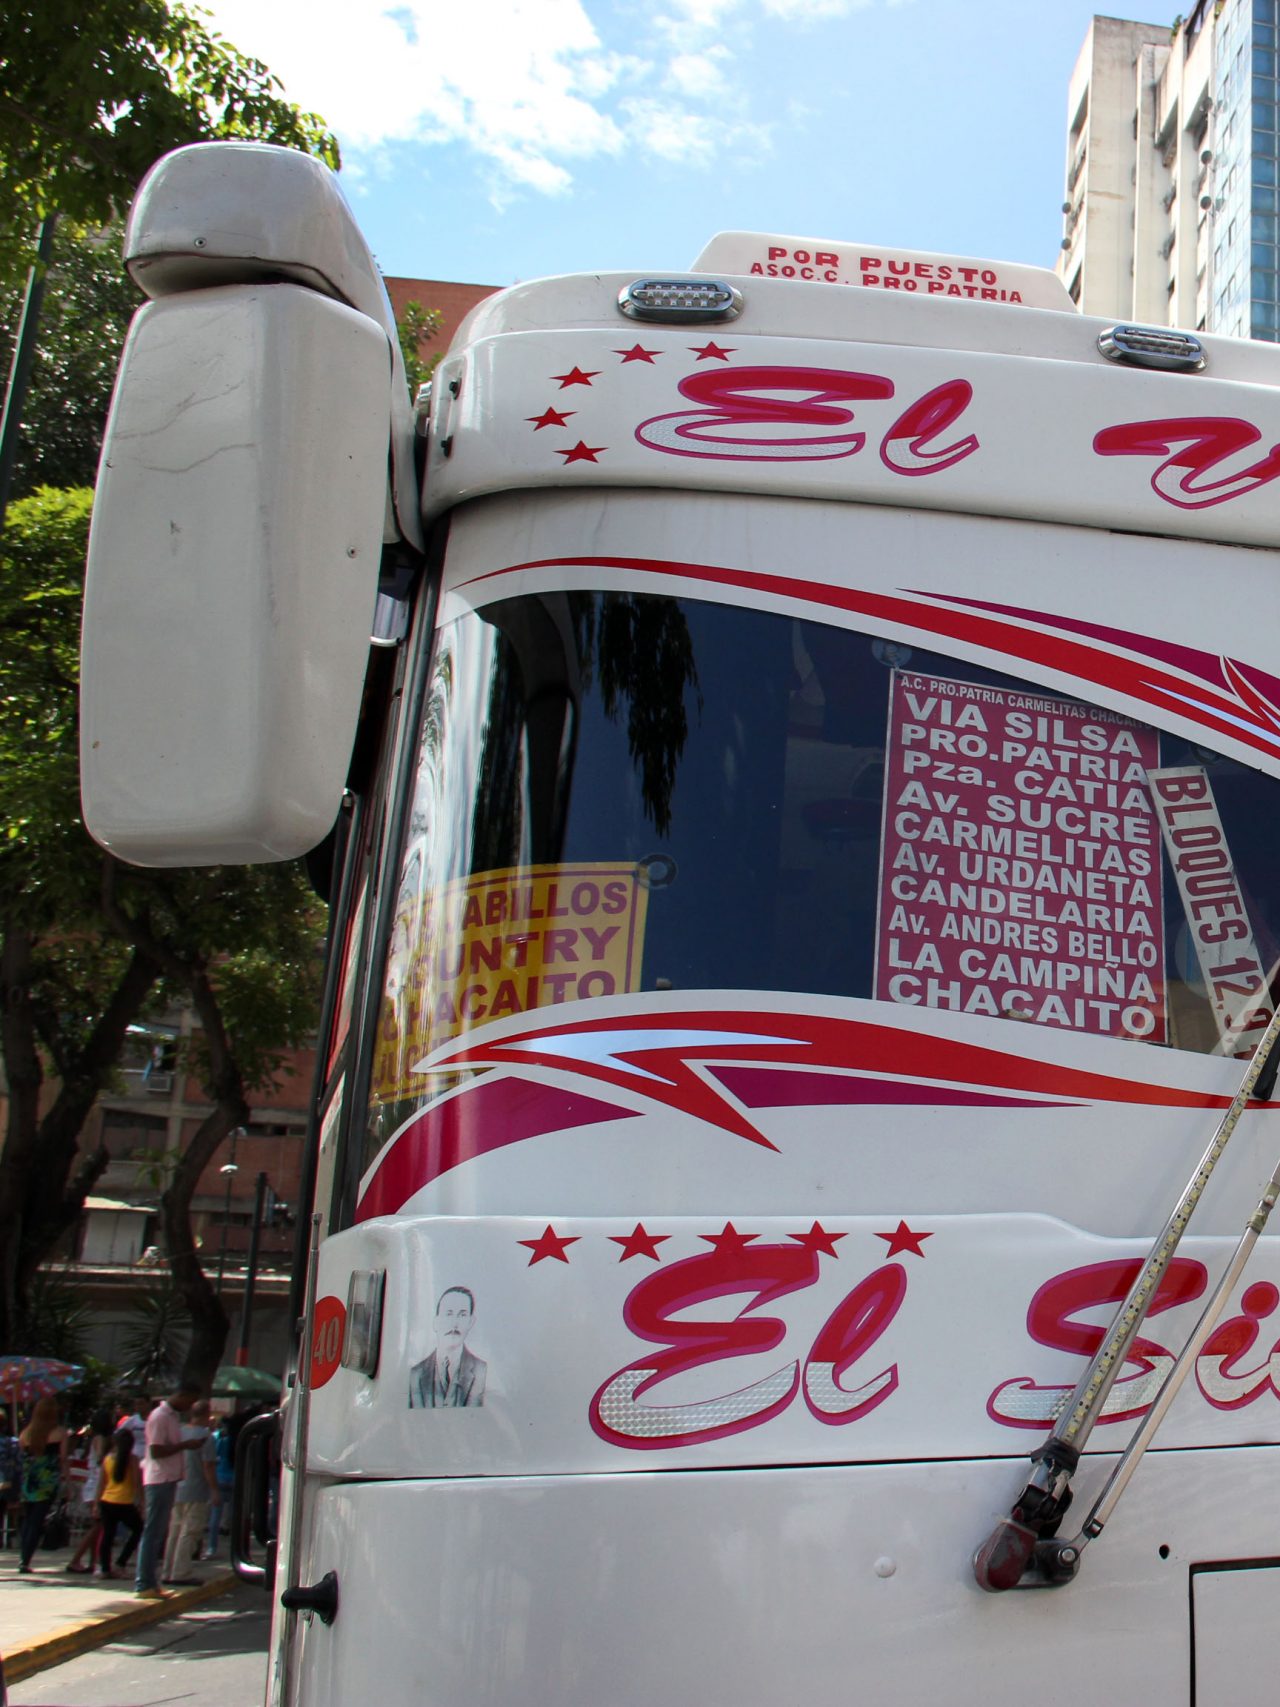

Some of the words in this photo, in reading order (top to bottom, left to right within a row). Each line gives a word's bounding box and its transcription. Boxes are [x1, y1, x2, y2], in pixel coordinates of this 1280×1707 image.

[768, 246, 840, 268] POR
[859, 256, 997, 286] PUESTO
[862, 273, 918, 292] PRO
[927, 281, 1023, 304] PATRIA
[634, 365, 980, 476] El
[900, 675, 926, 691] A.C.
[929, 681, 1004, 705] PRO.PATRIA
[1007, 694, 1086, 719] CARMELITAS
[904, 692, 988, 732] VIA
[1004, 712, 1143, 758] SILSA
[901, 723, 1148, 785] PRO.PATRIA
[903, 750, 997, 788] Pza.
[1013, 770, 1152, 814] CATIA
[894, 811, 1152, 876] CARMELITAS
[896, 780, 968, 815] Av.
[986, 795, 1152, 845] SUCRE
[892, 842, 945, 875] Av.
[959, 851, 1154, 908] URDANETA
[1155, 774, 1249, 944] BLOQUES
[438, 881, 628, 934] ABILLOS
[888, 904, 931, 936] Av.
[939, 911, 1059, 953] ANDRES
[1068, 931, 1158, 968] BELLO
[890, 874, 1154, 937] CANDELARIA
[888, 938, 944, 974] LA
[958, 948, 1157, 1003] CAMPIÑA
[888, 974, 1156, 1036] CHACAITO
[313, 1316, 341, 1366] 40
[588, 1243, 908, 1450] El
